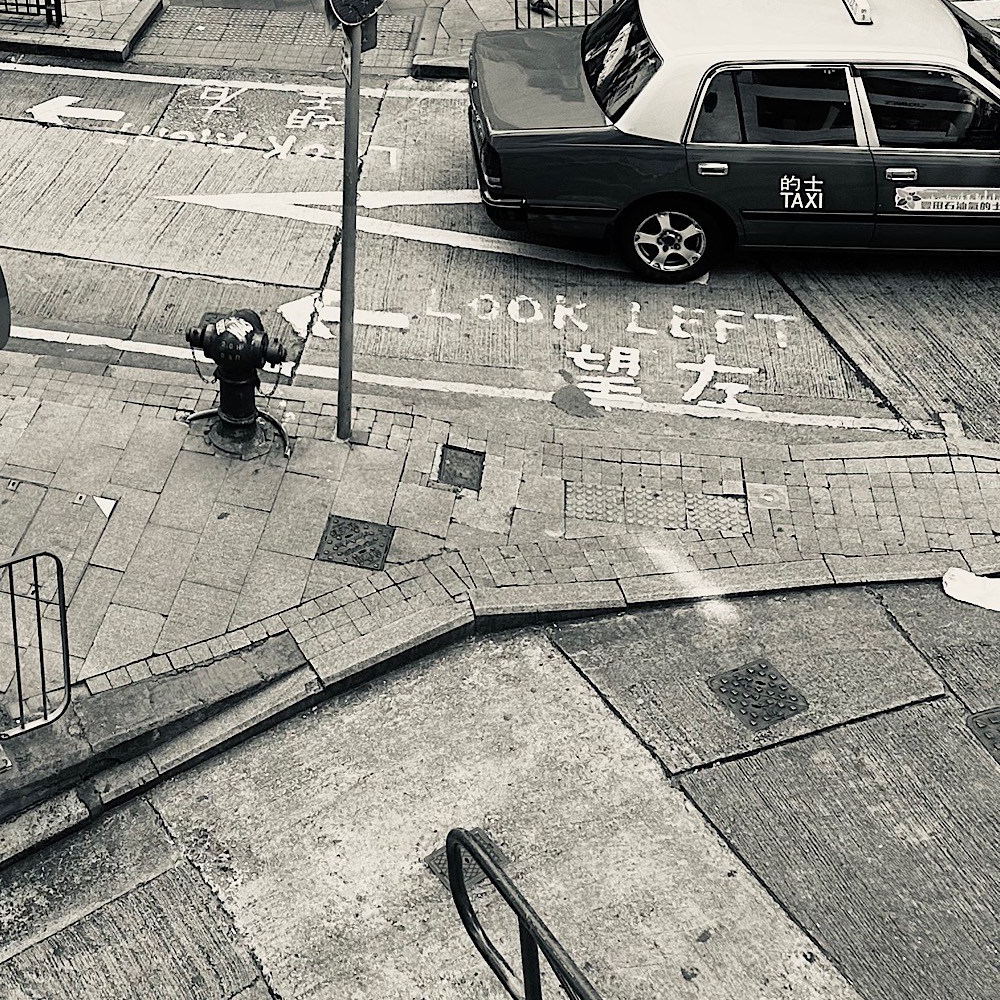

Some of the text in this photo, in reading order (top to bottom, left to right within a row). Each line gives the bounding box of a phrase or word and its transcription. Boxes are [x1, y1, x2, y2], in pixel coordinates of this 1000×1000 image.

[780, 175, 823, 192] 的士
[780, 192, 823, 209] TAXI
[427, 294, 796, 347] LOOK LEFT
[566, 344, 762, 413] 望左
